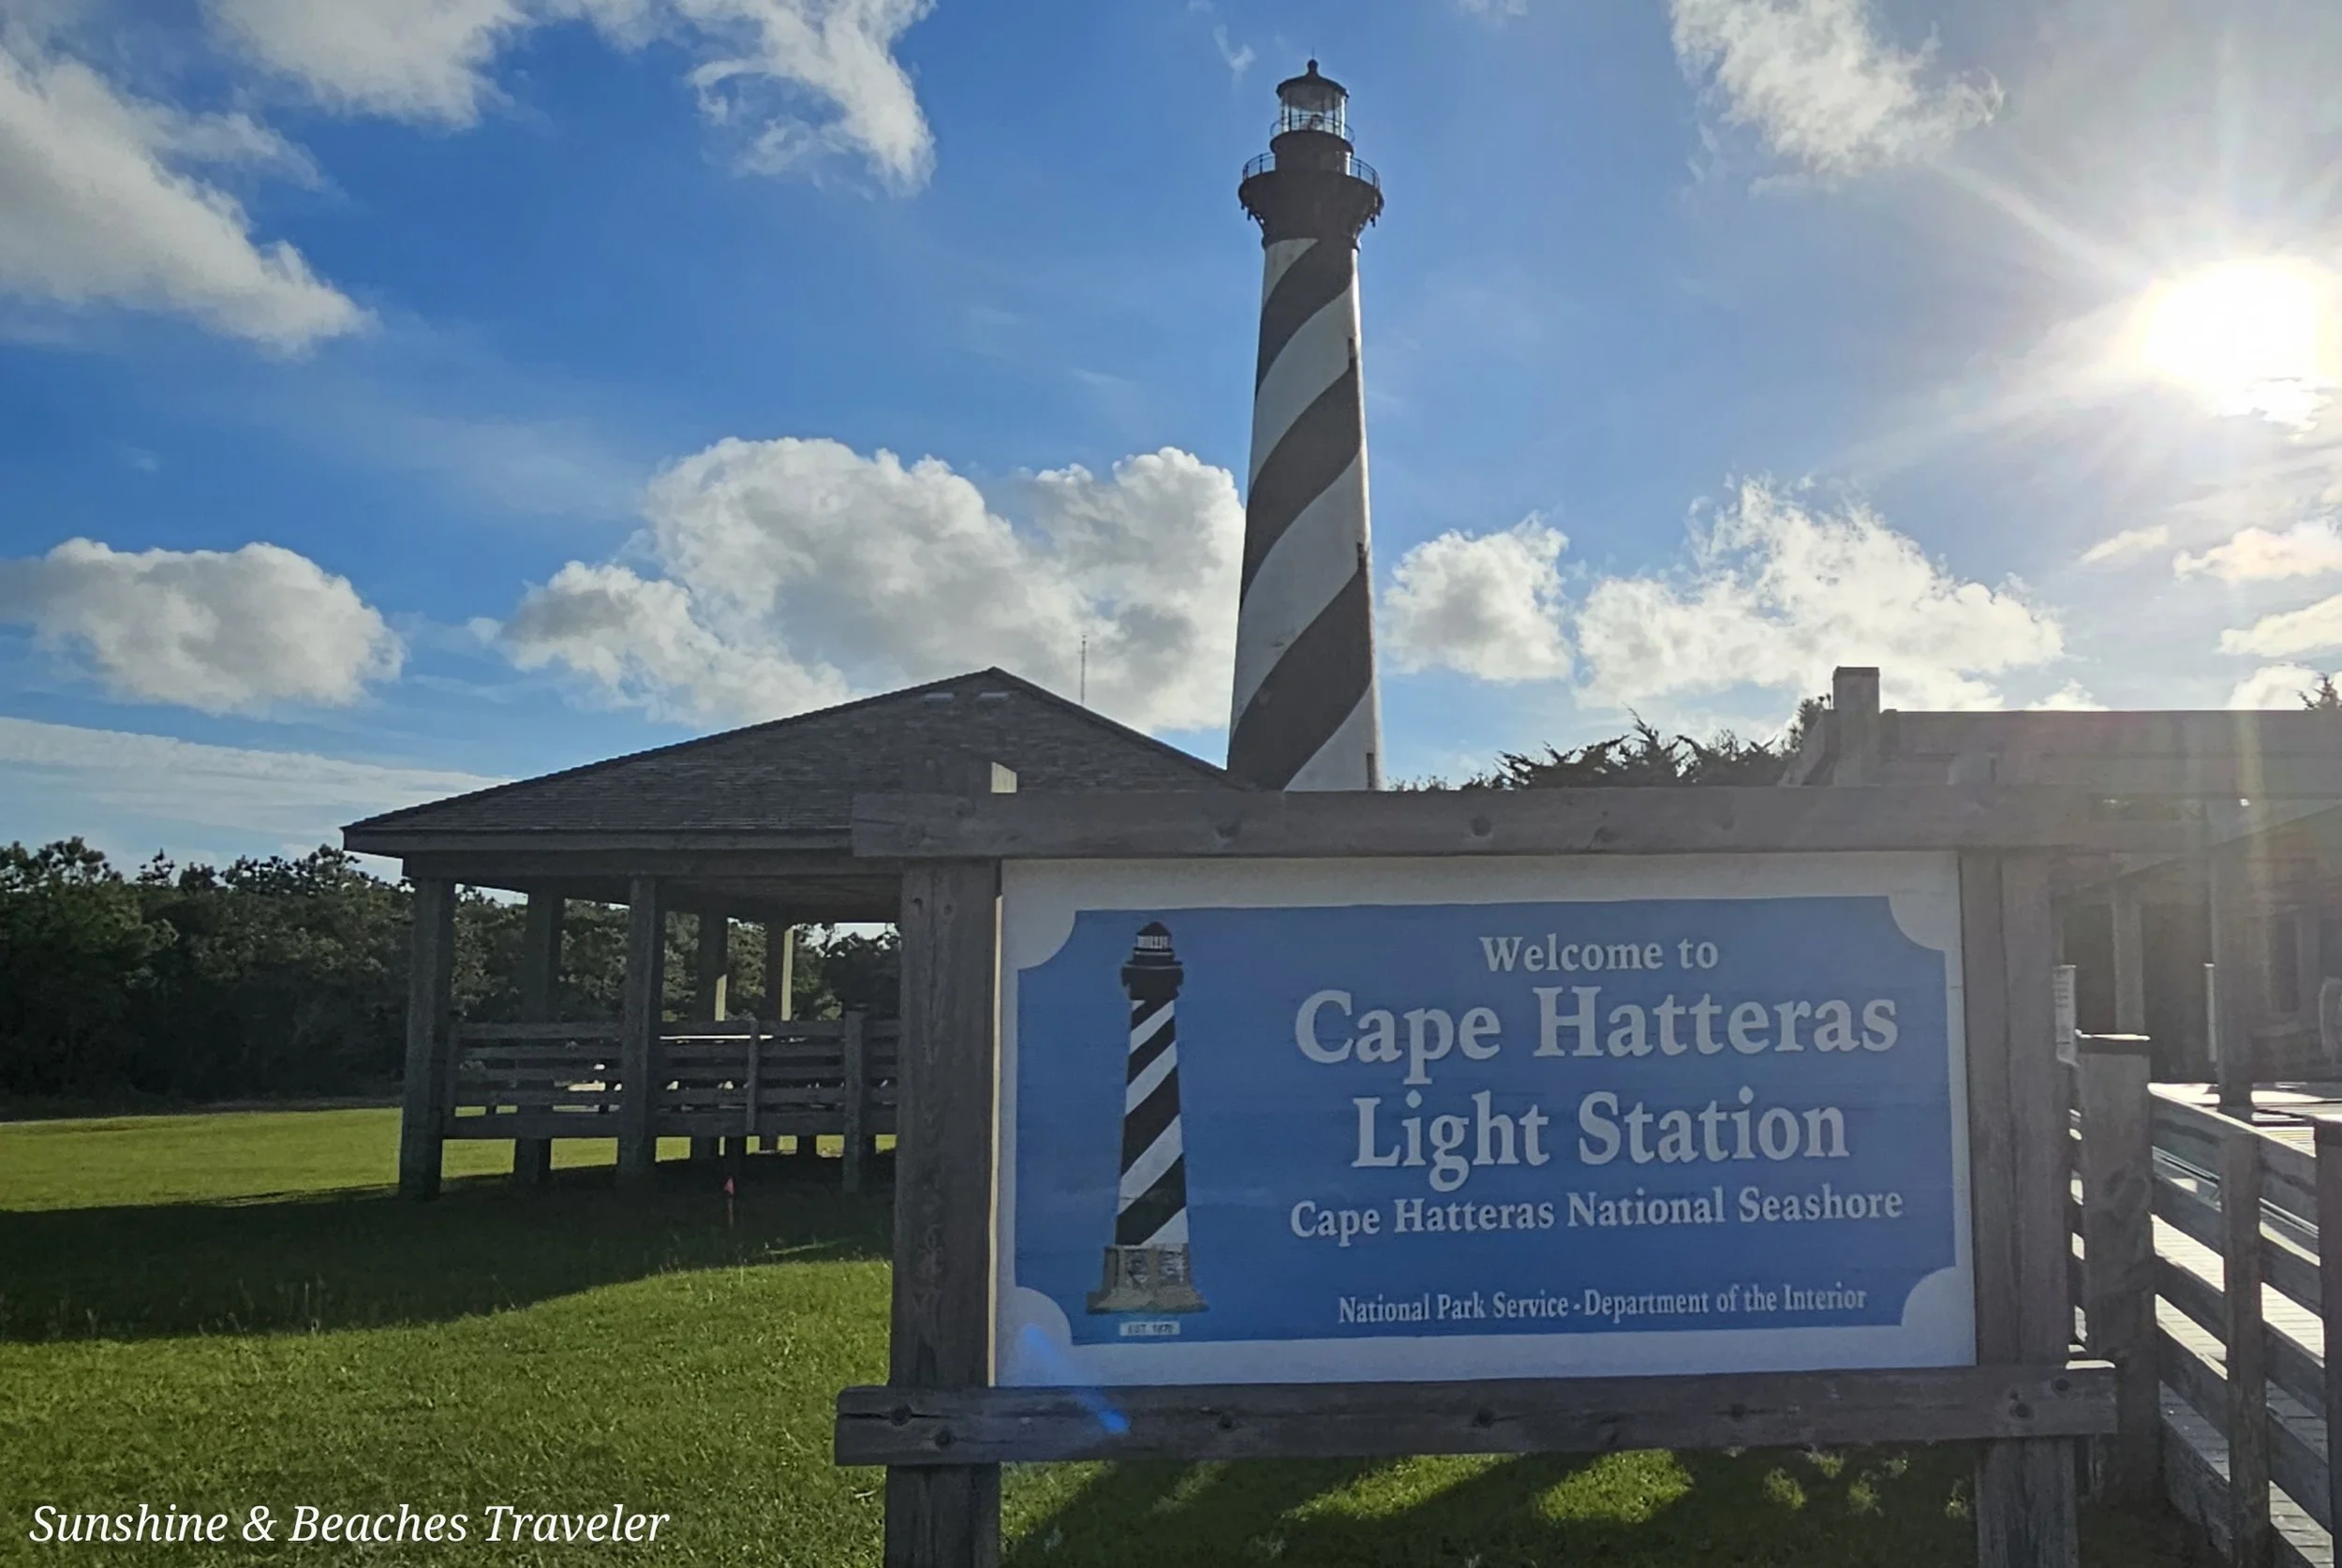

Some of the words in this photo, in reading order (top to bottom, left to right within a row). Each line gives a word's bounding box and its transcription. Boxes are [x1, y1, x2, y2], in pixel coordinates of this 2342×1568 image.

[1478, 932, 1664, 972] Welcome
[1677, 938, 1719, 969] to
[1295, 989, 1502, 1085] Cape
[1532, 985, 1899, 1058] Hatteras
[1351, 1089, 1550, 1192] Light
[1579, 1085, 1850, 1165] Station
[1290, 1200, 1381, 1248] Cape
[1393, 1198, 1555, 1233] Hatteras
[1566, 1185, 1727, 1228] National
[1738, 1183, 1904, 1222] Seashore
[1338, 1293, 1430, 1324] National
[1436, 1292, 1487, 1320] Park
[1715, 1284, 1741, 1313] of
[1742, 1284, 1778, 1313] the
[1783, 1281, 1868, 1311] Interior
